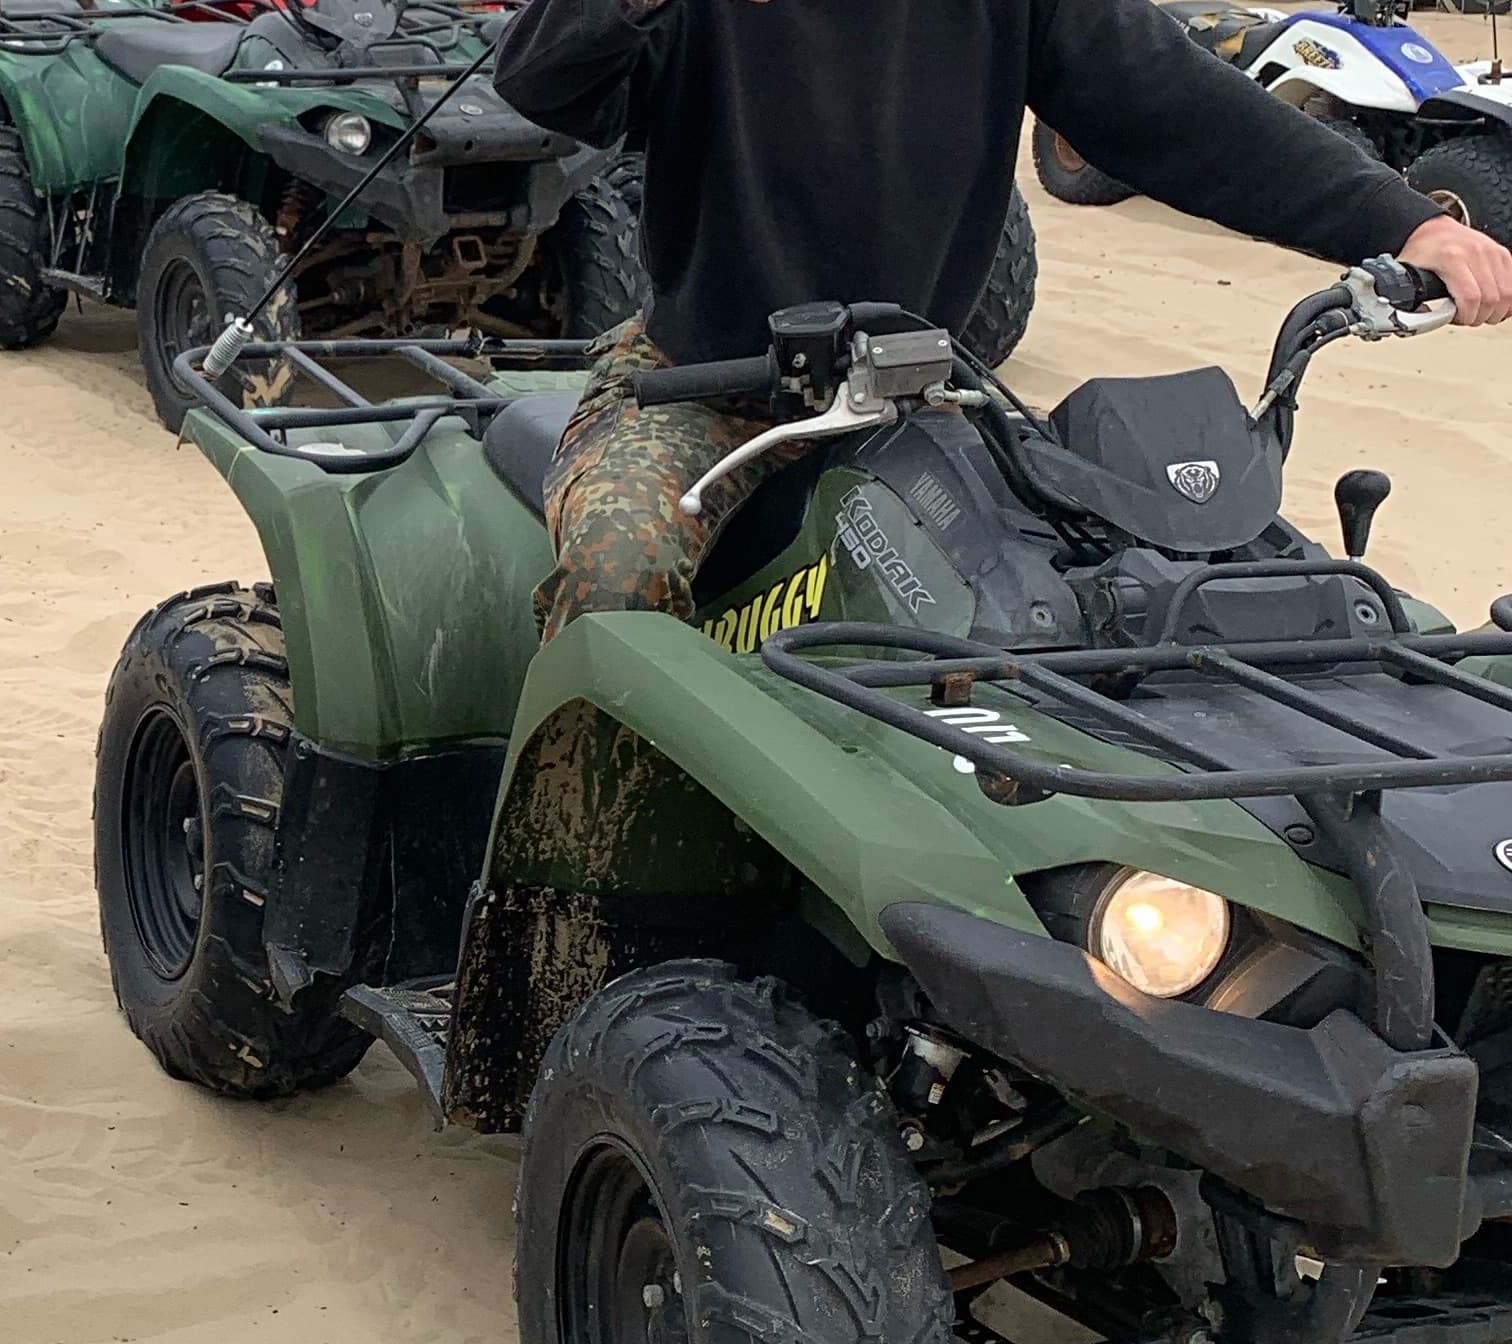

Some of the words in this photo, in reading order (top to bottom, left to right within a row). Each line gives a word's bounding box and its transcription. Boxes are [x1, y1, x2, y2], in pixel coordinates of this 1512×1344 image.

[909, 471, 961, 532] YAMAHA
[835, 511, 872, 570] 450
[839, 485, 937, 614] KODIAK
